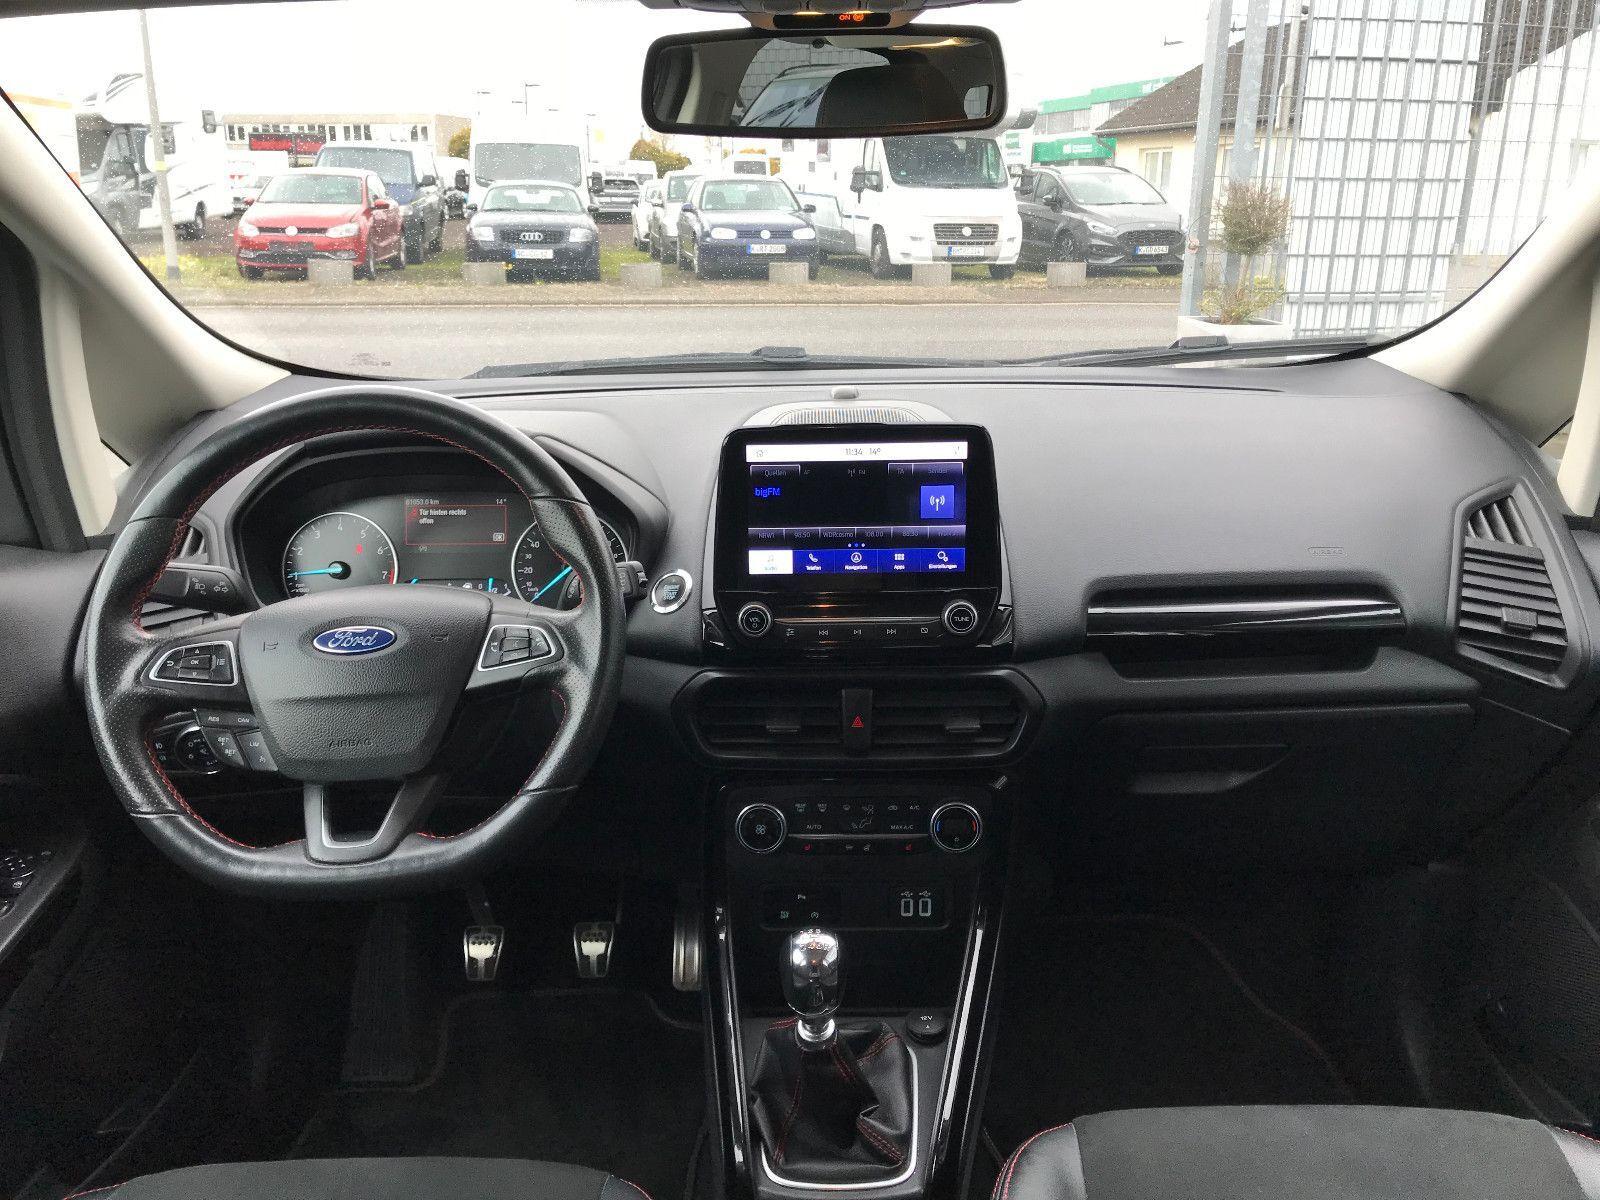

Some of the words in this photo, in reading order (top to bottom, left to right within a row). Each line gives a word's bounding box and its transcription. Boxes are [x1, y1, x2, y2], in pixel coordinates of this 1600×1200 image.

[845, 448, 863, 456] 11:34
[754, 487, 781, 498] bigFM
[327, 628, 379, 648] Ford
